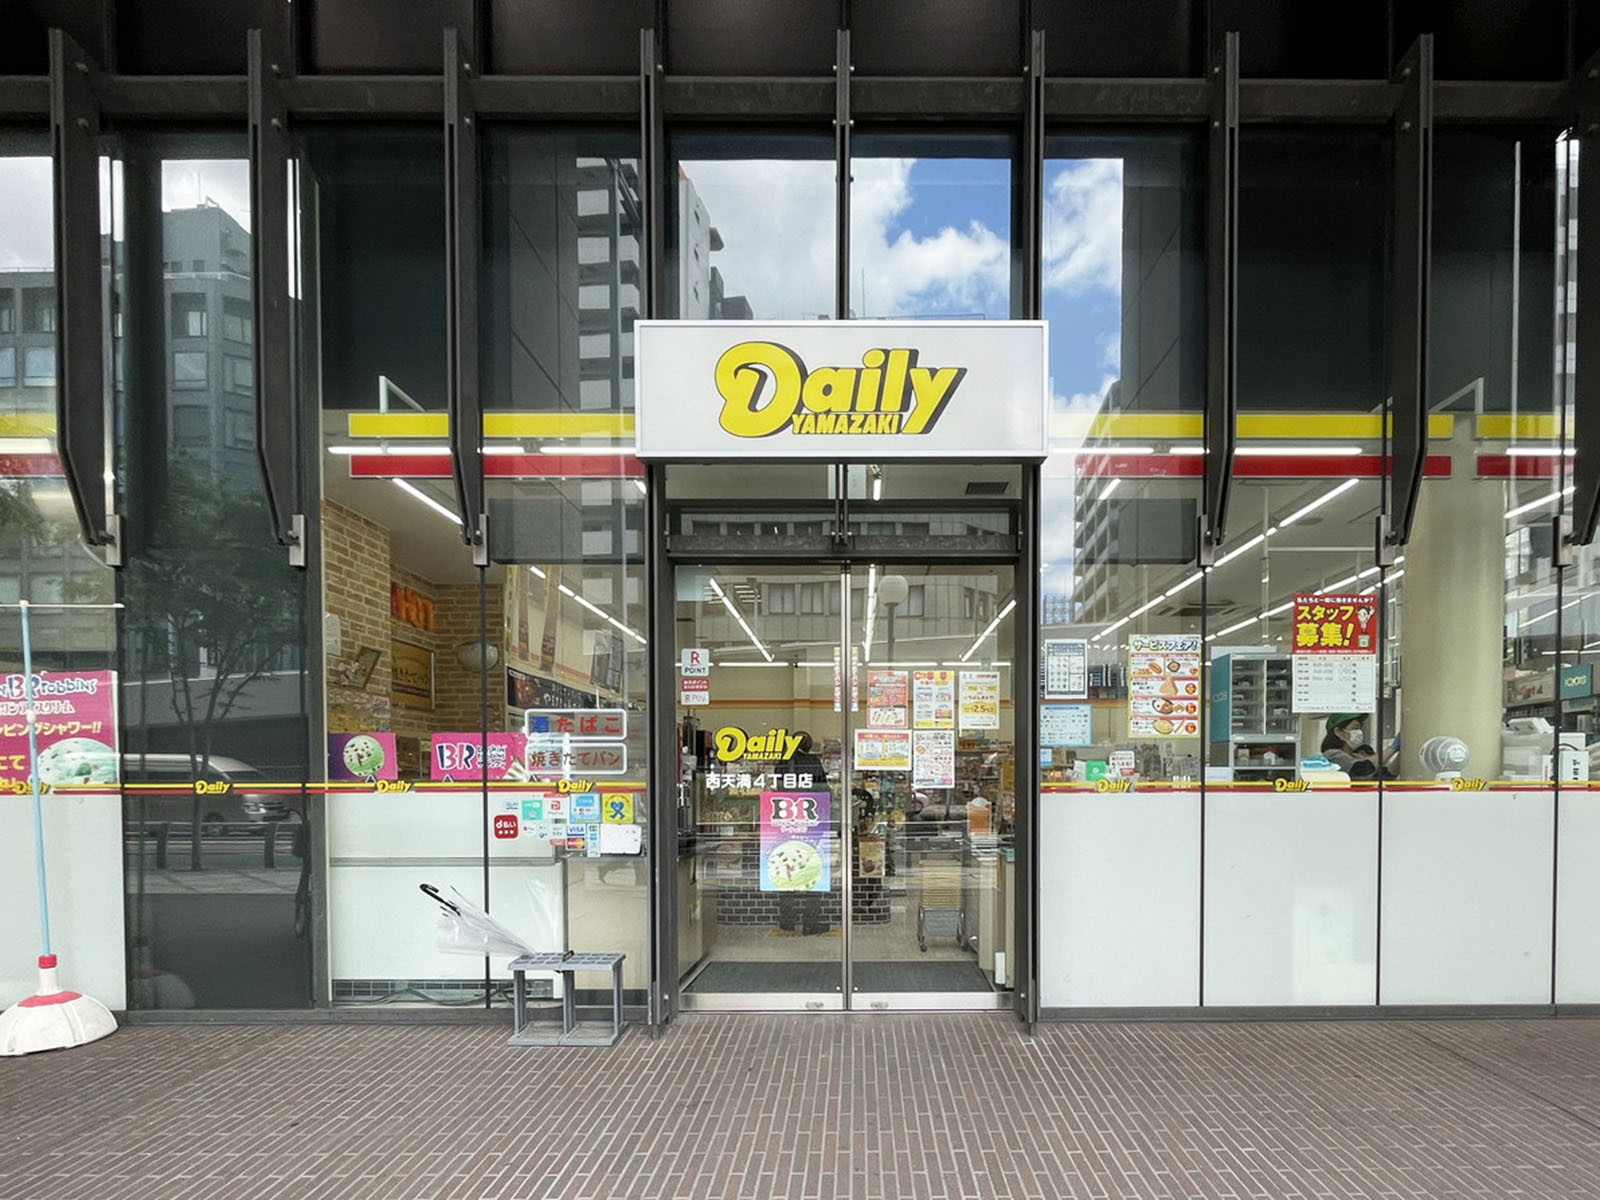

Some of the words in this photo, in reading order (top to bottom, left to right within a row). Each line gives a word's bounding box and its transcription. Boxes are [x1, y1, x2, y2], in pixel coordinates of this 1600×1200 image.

[714, 341, 966, 437] Daily
[792, 413, 903, 434] YAMAZAKI
[1297, 605, 1355, 621] スタッフ
[1296, 622, 1355, 647] 募集!
[1133, 639, 1198, 651] サービスフェア!
[690, 651, 701, 664] R
[556, 715, 620, 733] たばこ
[715, 727, 803, 761] Daily
[437, 743, 476, 770] BR
[531, 751, 621, 767] 焼きたてパン
[743, 753, 783, 761] YAMAZAKI
[195, 780, 232, 794] Daily
[376, 780, 412, 793] Daily
[557, 779, 594, 793] Daily
[1096, 778, 1132, 793] Daily
[1274, 778, 1310, 793] Daily
[1452, 777, 1487, 791] Daily
[772, 799, 817, 820] BR
